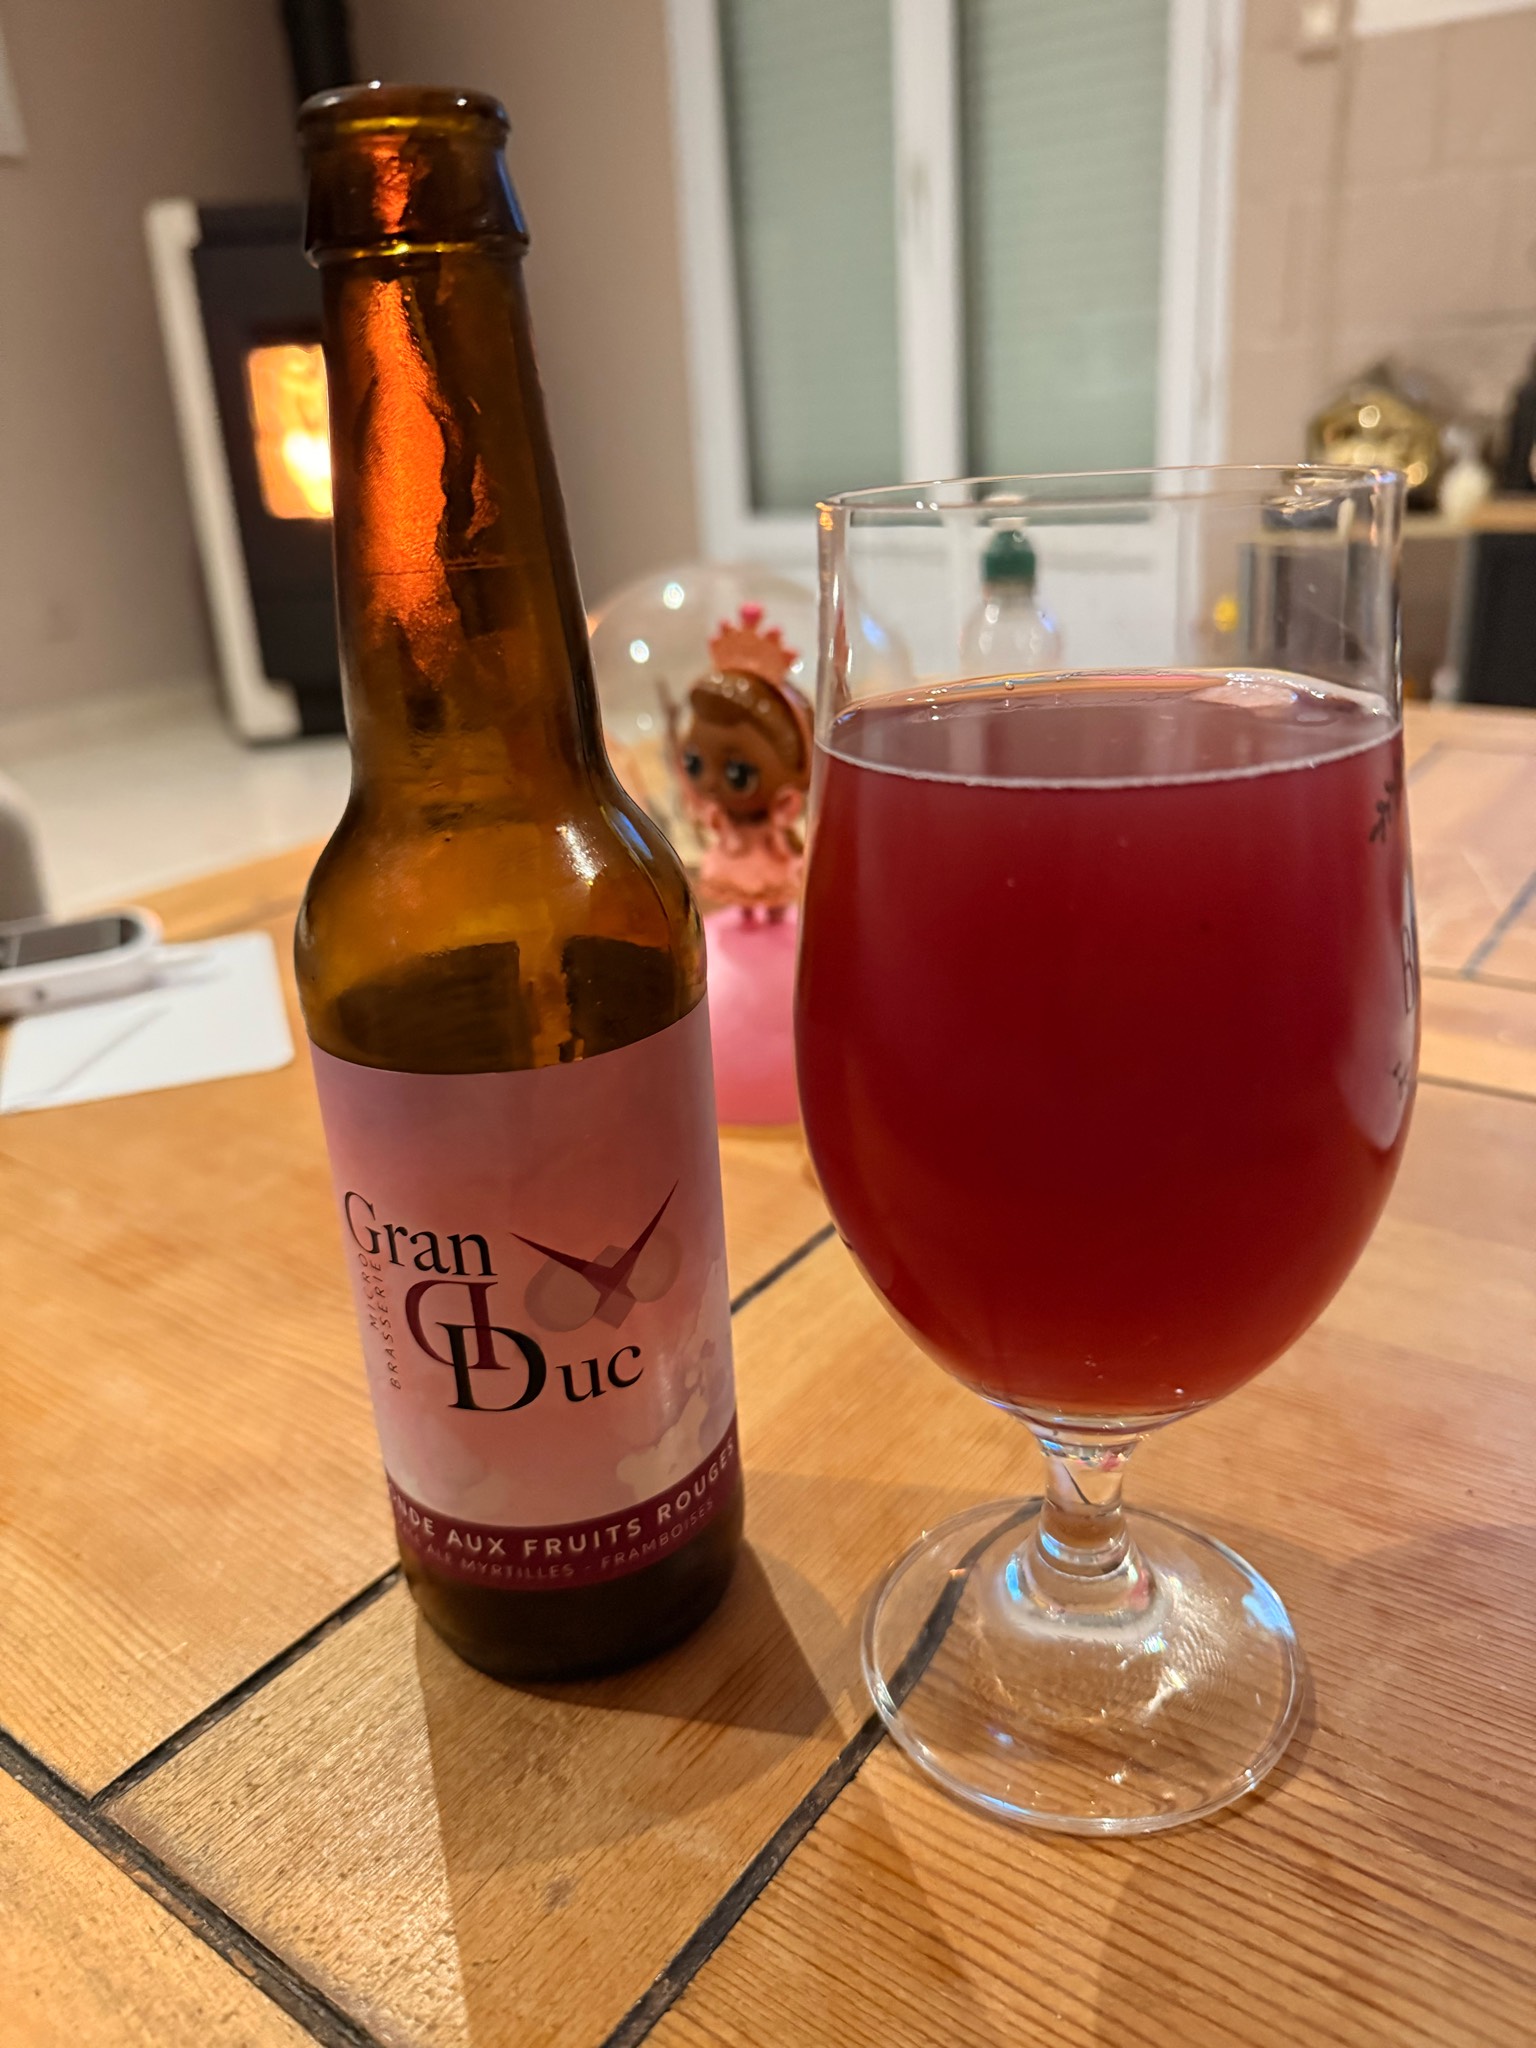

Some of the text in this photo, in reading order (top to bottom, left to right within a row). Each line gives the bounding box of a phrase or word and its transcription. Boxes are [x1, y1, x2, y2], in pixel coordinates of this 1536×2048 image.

[344, 1190, 498, 1277] Gran
[358, 1253, 380, 1330] MICRO
[369, 1260, 402, 1390] BRASSERIE
[447, 1529, 507, 1556] AUX
[523, 1517, 642, 1558] FRUITS
[656, 1437, 734, 1525] ROUGES
[460, 1556, 575, 1580] MYRTILLES
[600, 1498, 714, 1570] FRAMBOISES
